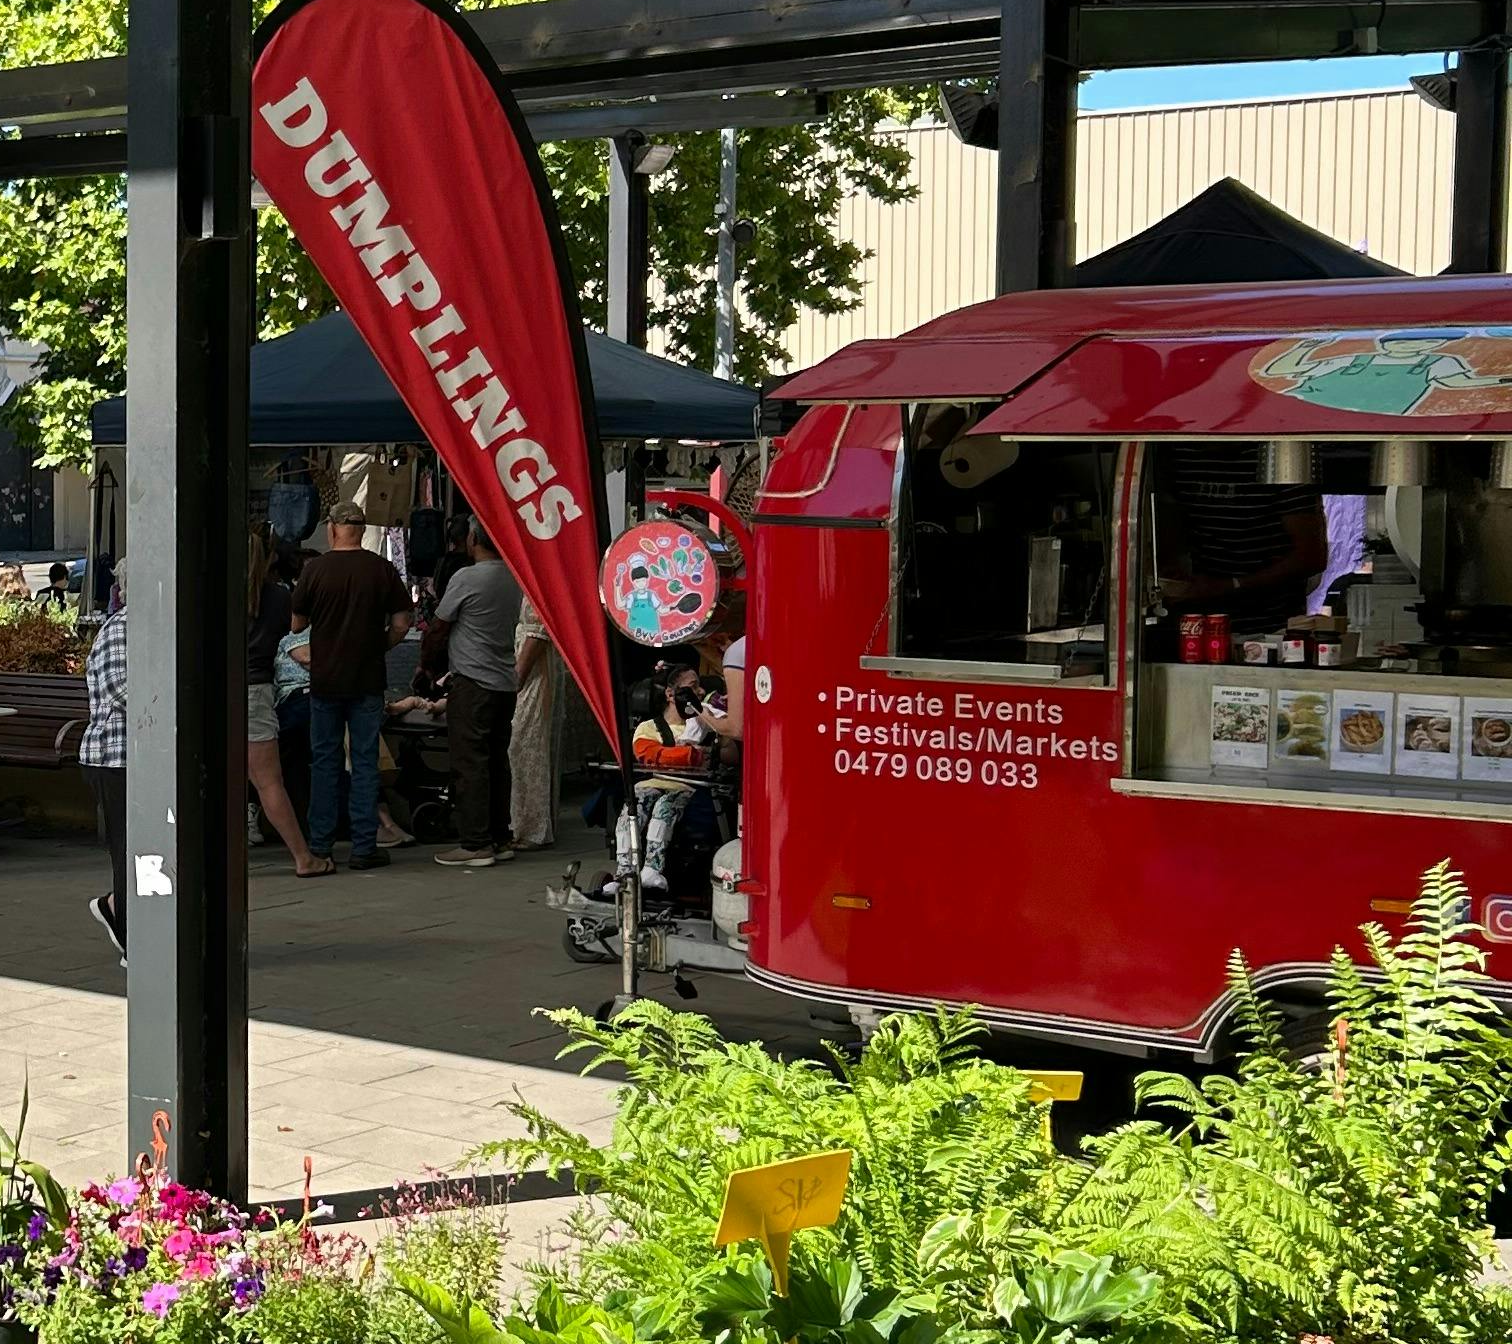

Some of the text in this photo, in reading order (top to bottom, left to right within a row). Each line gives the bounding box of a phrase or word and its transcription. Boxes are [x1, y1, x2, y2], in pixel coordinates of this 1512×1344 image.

[259, 76, 583, 541] DUMPLINGS
[835, 686, 1064, 724] Private Events
[835, 717, 1119, 762] Festivals/Markets
[834, 749, 1038, 789] 0479 089 033
